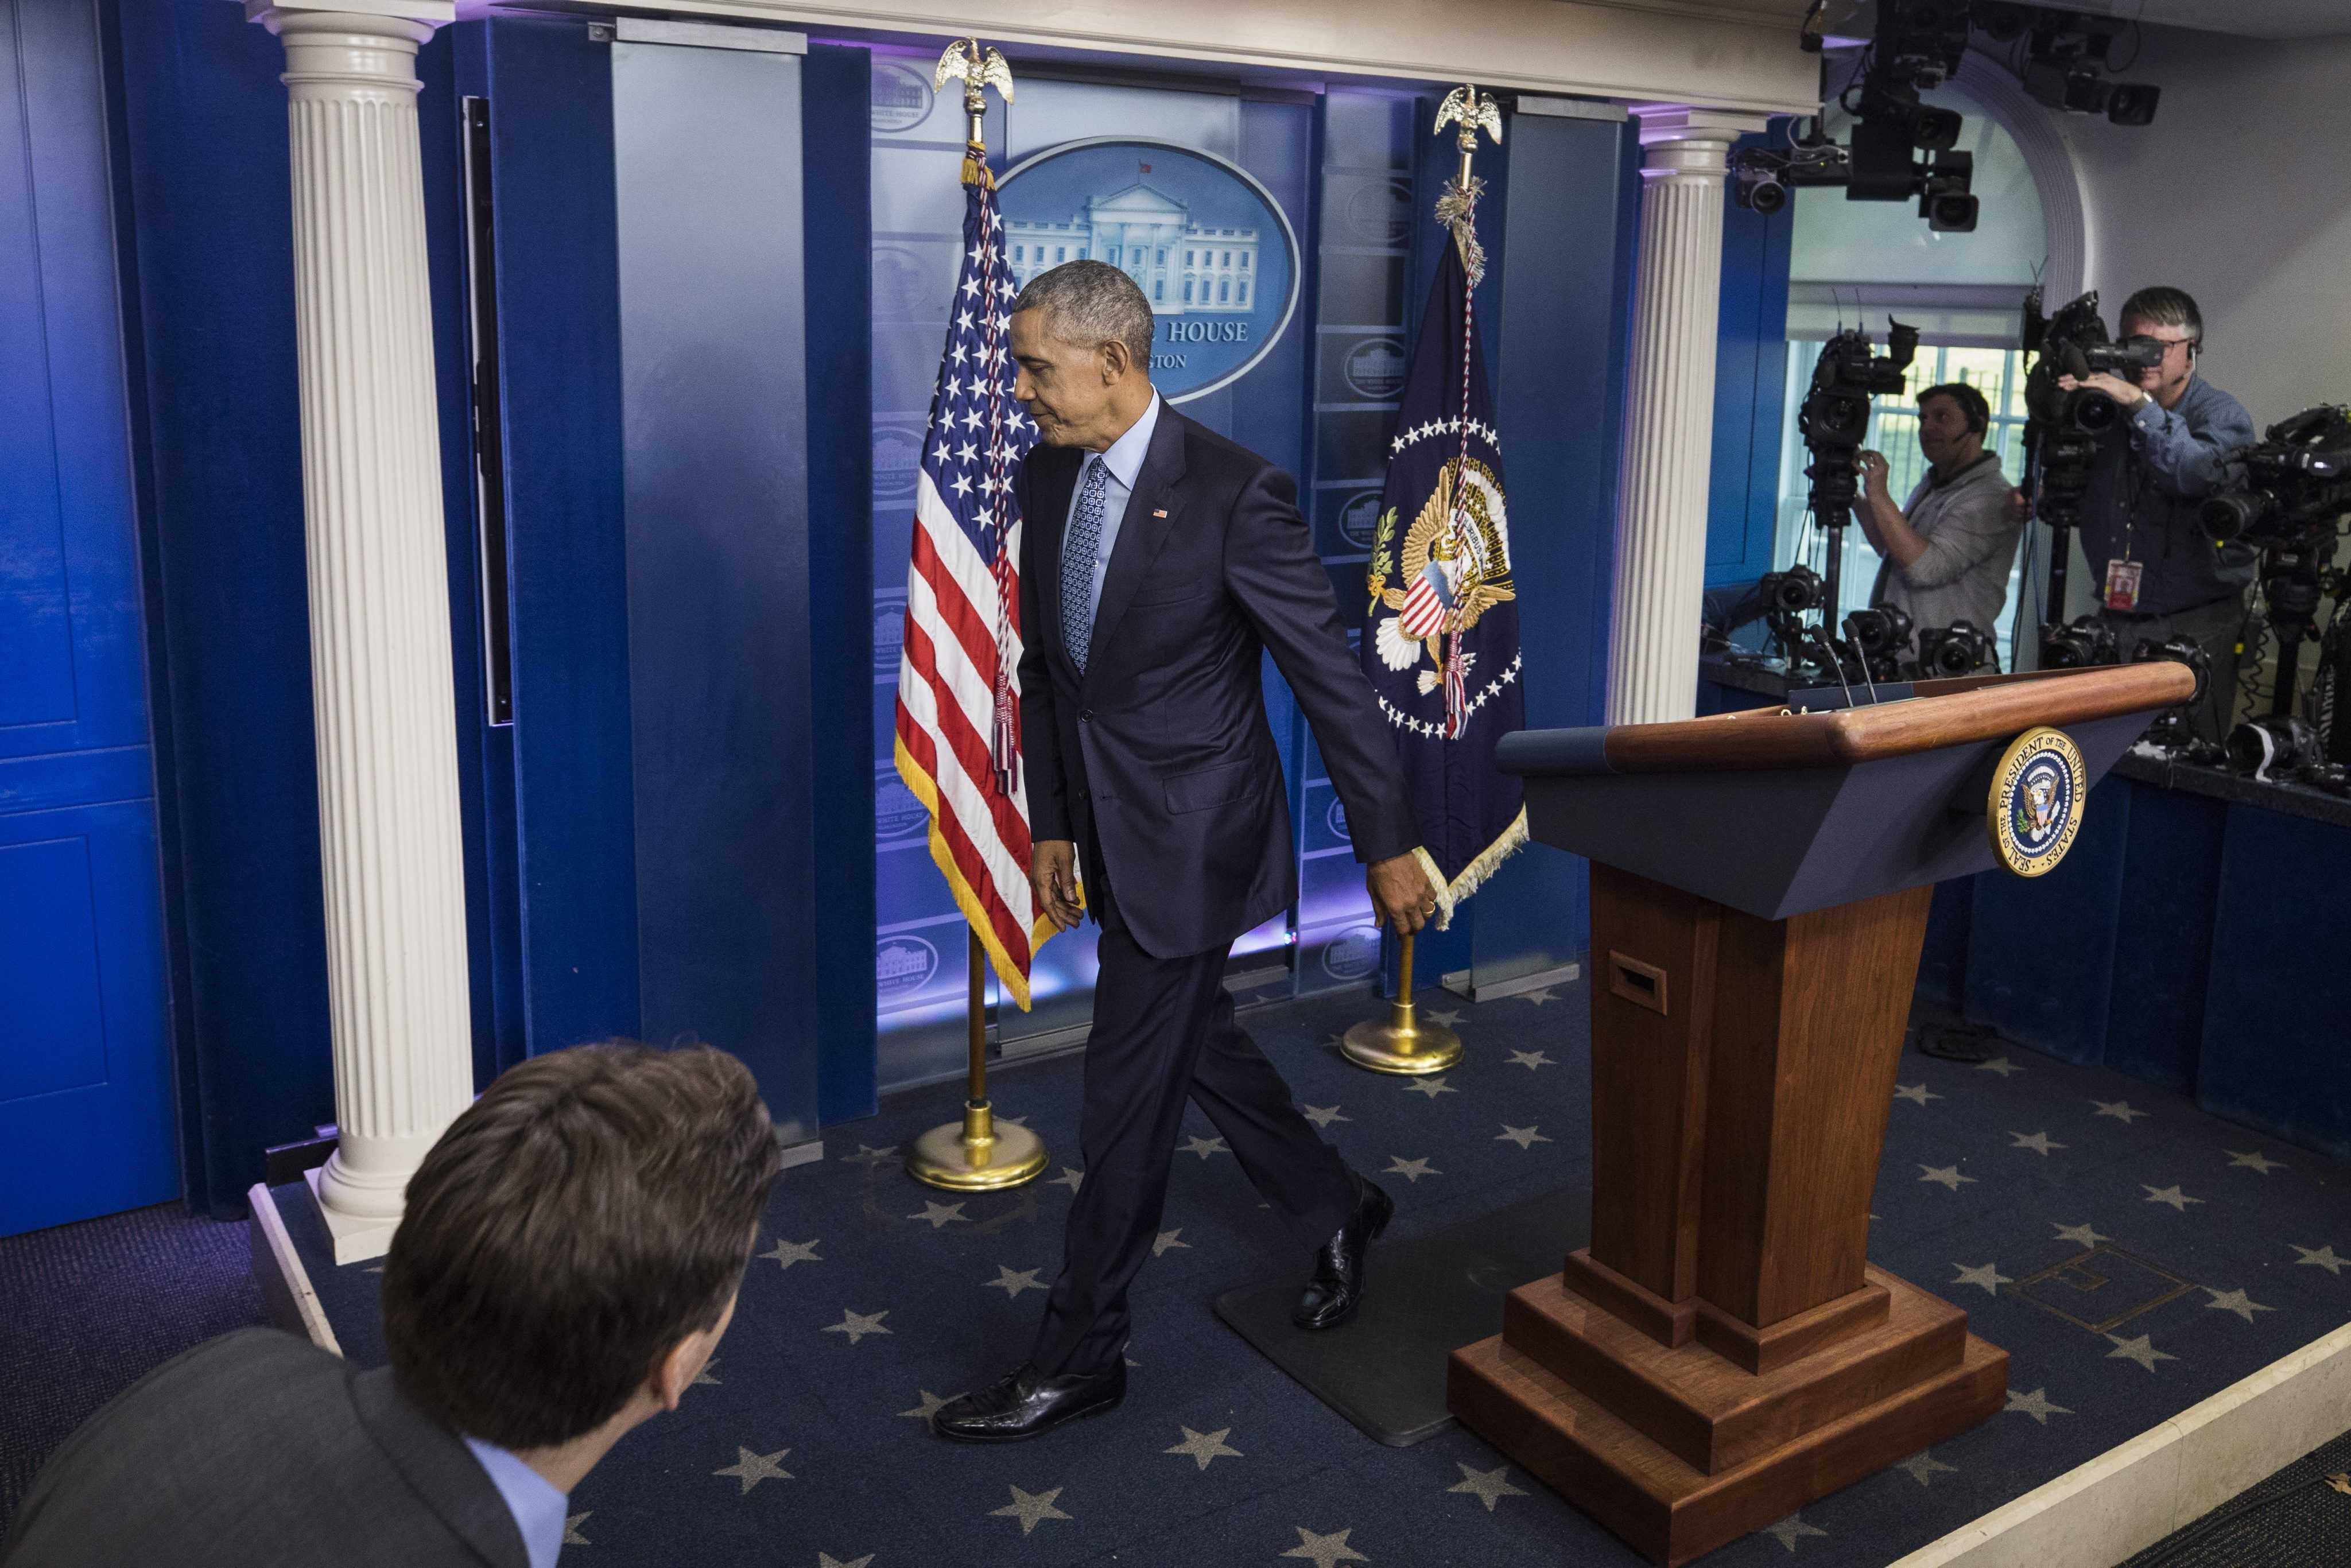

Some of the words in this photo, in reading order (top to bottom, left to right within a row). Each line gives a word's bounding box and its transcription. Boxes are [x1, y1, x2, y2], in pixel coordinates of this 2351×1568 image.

[1169, 321, 1248, 342] HOUSE
[2046, 737, 2054, 746] OF
[2055, 738, 2067, 751] THE
[2000, 737, 2043, 809] PRESIDENT
[2067, 747, 2083, 802] UNITED
[2002, 837, 2009, 848] OF
[2046, 817, 2077, 865] STATES
[2009, 847, 2031, 872] SEAL
